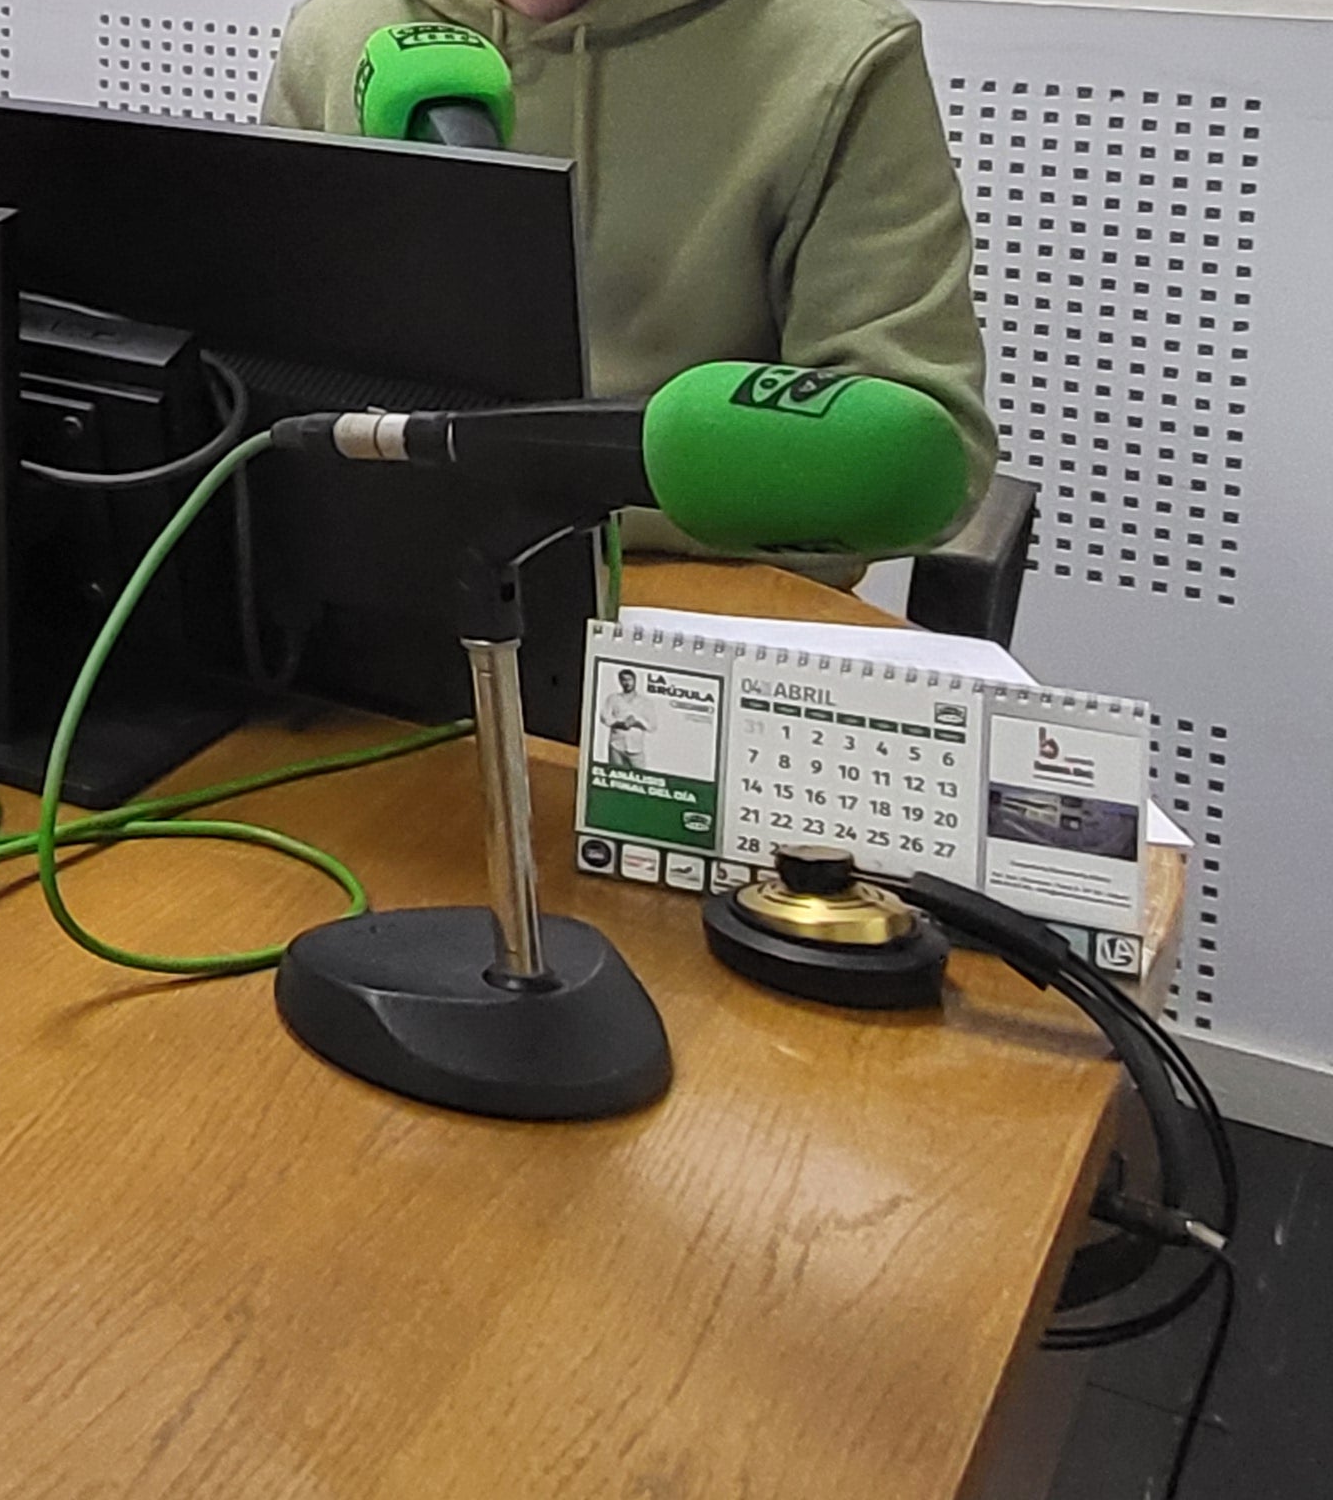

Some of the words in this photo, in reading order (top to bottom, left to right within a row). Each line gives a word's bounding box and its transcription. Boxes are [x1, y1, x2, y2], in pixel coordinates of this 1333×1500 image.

[646, 673, 666, 685] LA
[646, 685, 715, 703] BRÚJULA
[741, 679, 762, 694] 04
[773, 683, 835, 707] ABRIL
[781, 725, 790, 740] 1
[811, 730, 824, 746] 2
[843, 735, 856, 751] 3
[876, 741, 889, 756] 4
[908, 746, 922, 762] 5
[942, 751, 955, 767] 6
[748, 748, 759, 764] 7
[778, 754, 791, 770] 8
[810, 759, 823, 774] 9
[838, 764, 860, 782] 10
[871, 770, 891, 787] 11
[903, 775, 925, 793] 12
[936, 781, 958, 799] 13
[741, 777, 763, 794] 14
[773, 783, 794, 800] 15
[804, 788, 827, 806] 16
[837, 794, 859, 811] 17
[869, 800, 892, 817] 18
[901, 805, 924, 822] 19
[933, 810, 959, 829] 20
[736, 835, 761, 854] 28
[739, 806, 760, 824] 21
[770, 812, 793, 830] 22
[802, 817, 825, 836] 23
[834, 823, 858, 841] 24
[866, 829, 891, 847] 25
[899, 834, 924, 853] 26
[933, 841, 957, 859] 27
